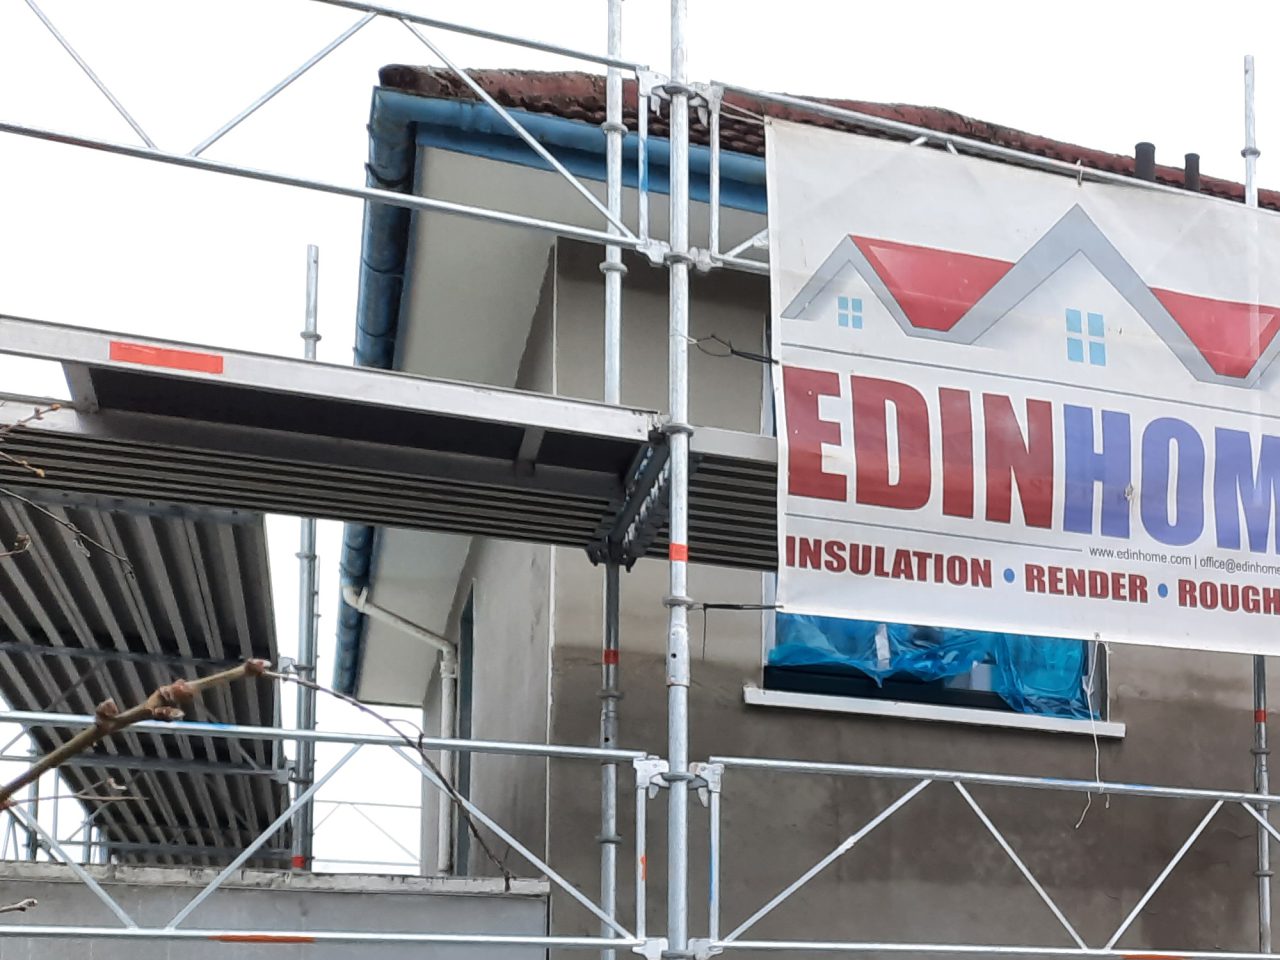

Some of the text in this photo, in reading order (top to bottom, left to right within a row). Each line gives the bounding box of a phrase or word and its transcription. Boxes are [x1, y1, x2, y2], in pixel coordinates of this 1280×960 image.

[785, 535, 992, 588] INSULATION
[1025, 564, 1148, 603] RENDER
[1089, 547, 1191, 566] www.edinhome.com
